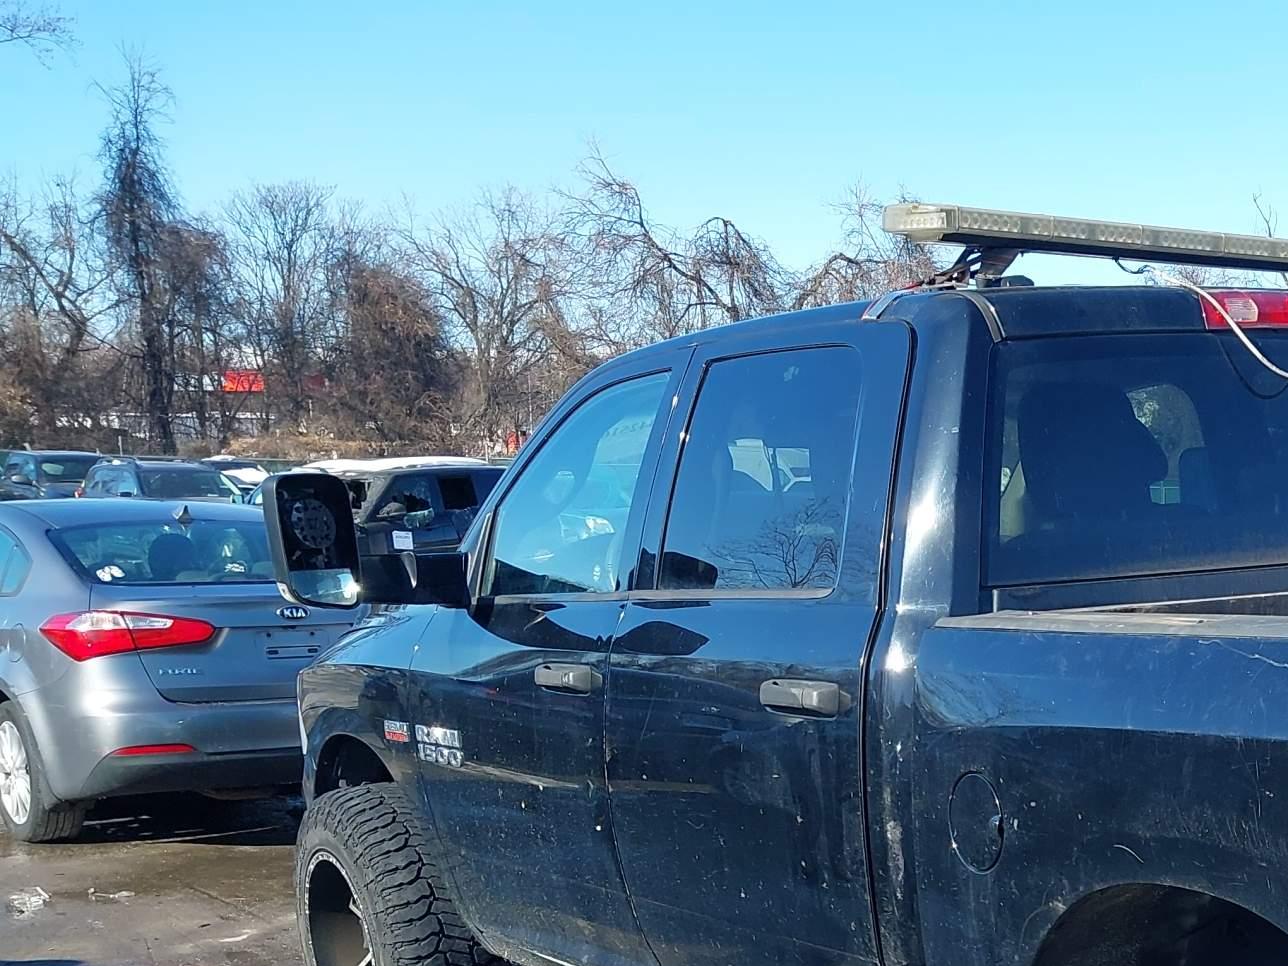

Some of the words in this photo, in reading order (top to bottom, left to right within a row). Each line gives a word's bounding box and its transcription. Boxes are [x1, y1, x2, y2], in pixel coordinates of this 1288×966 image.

[283, 608, 306, 618] KIA
[415, 724, 462, 748] RAM
[417, 743, 464, 768] 1500
